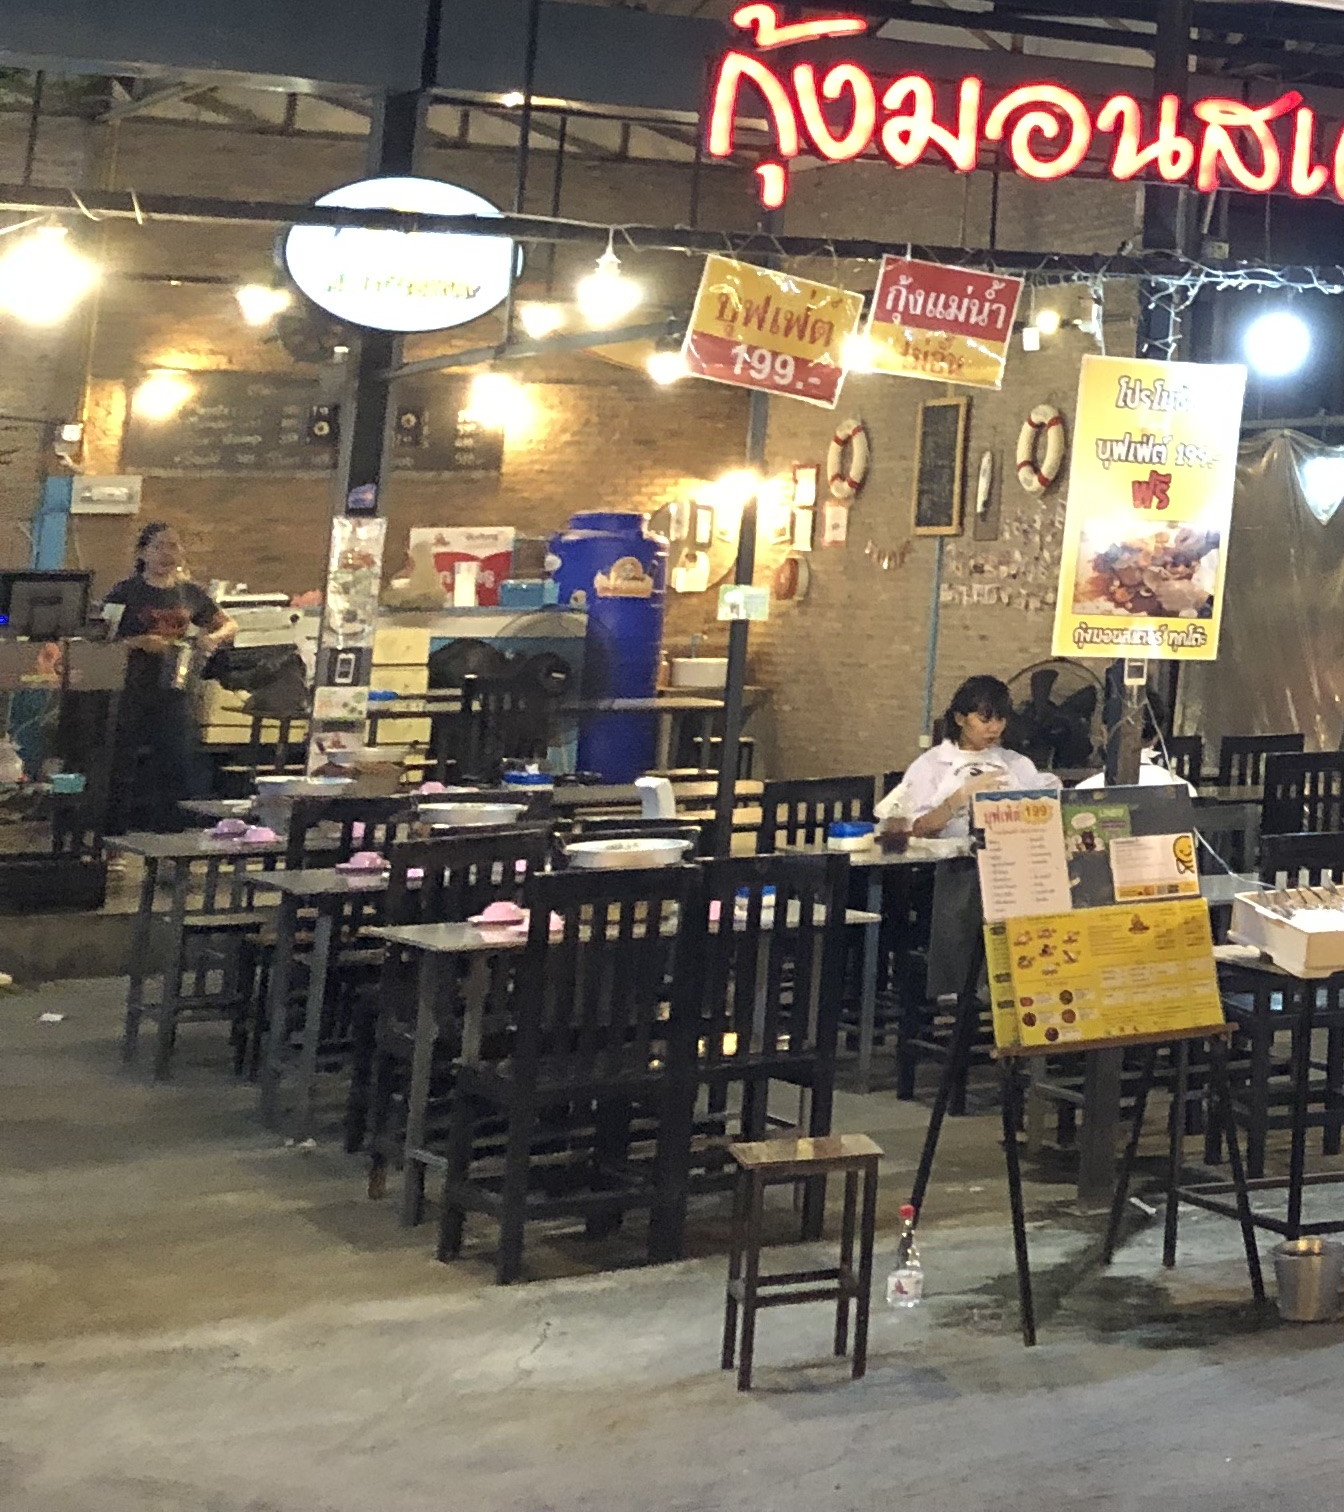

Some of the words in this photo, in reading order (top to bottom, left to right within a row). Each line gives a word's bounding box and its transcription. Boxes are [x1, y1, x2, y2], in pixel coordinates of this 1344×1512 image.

[885, 275, 1007, 329] กุ้งแม่น้ำ
[1131, 469, 1173, 510] ฟรี
